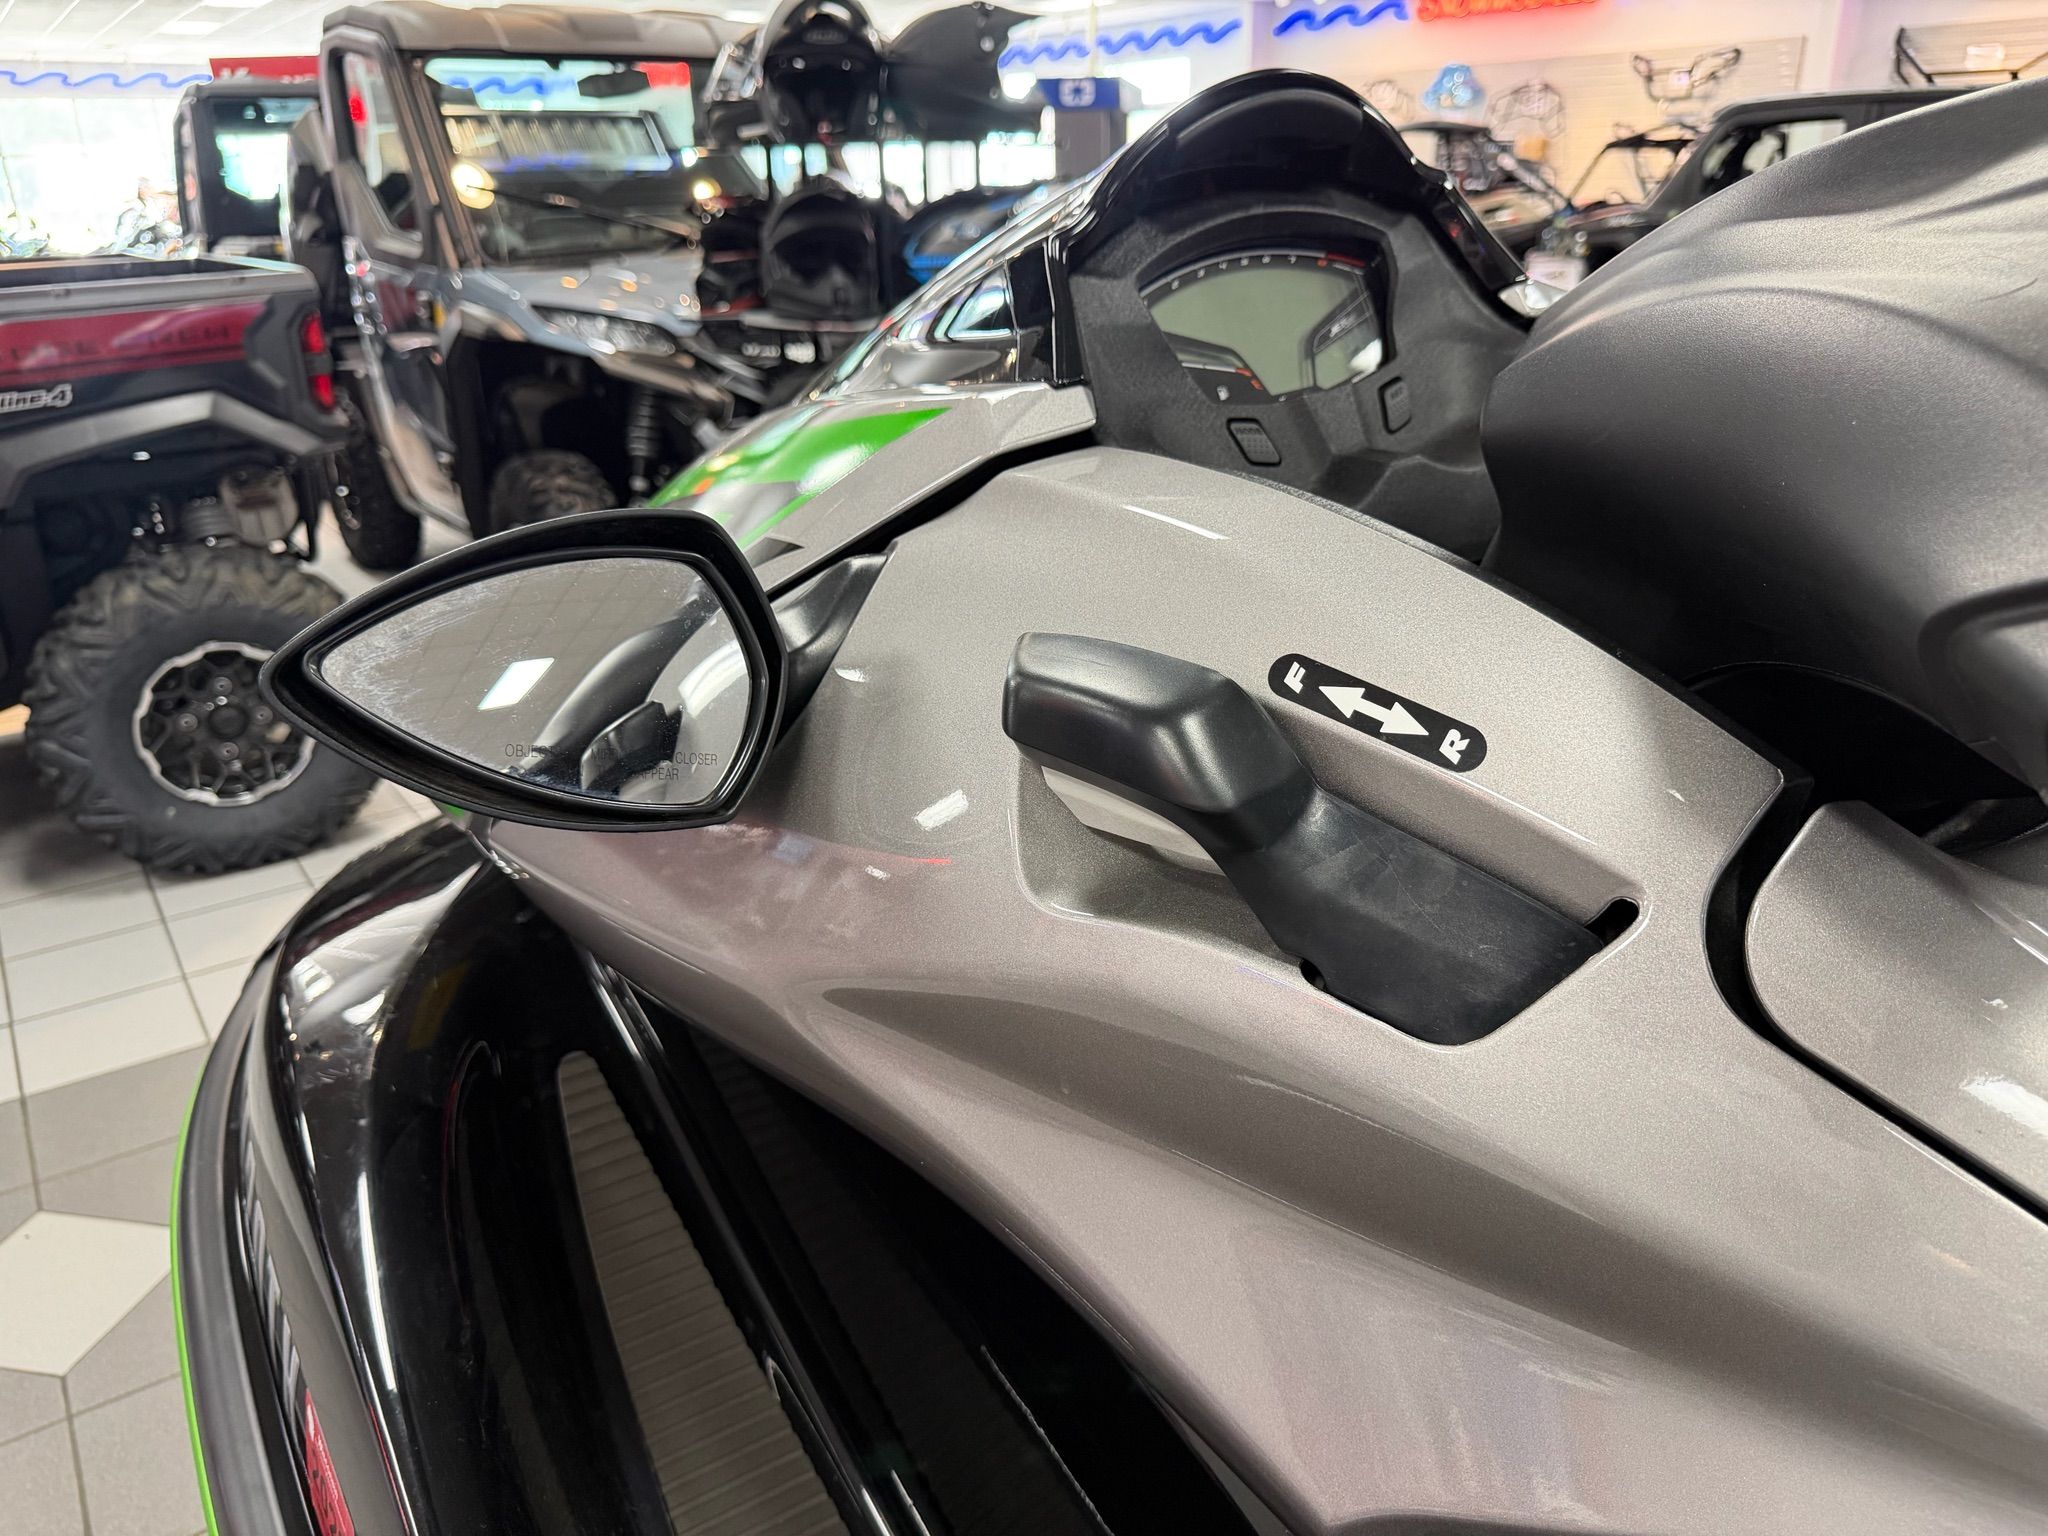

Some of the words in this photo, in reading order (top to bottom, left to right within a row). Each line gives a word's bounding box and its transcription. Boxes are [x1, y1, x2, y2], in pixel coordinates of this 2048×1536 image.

[1284, 661, 1306, 694] F
[1439, 728, 1470, 765] R
[675, 752, 718, 766] CLOSER
